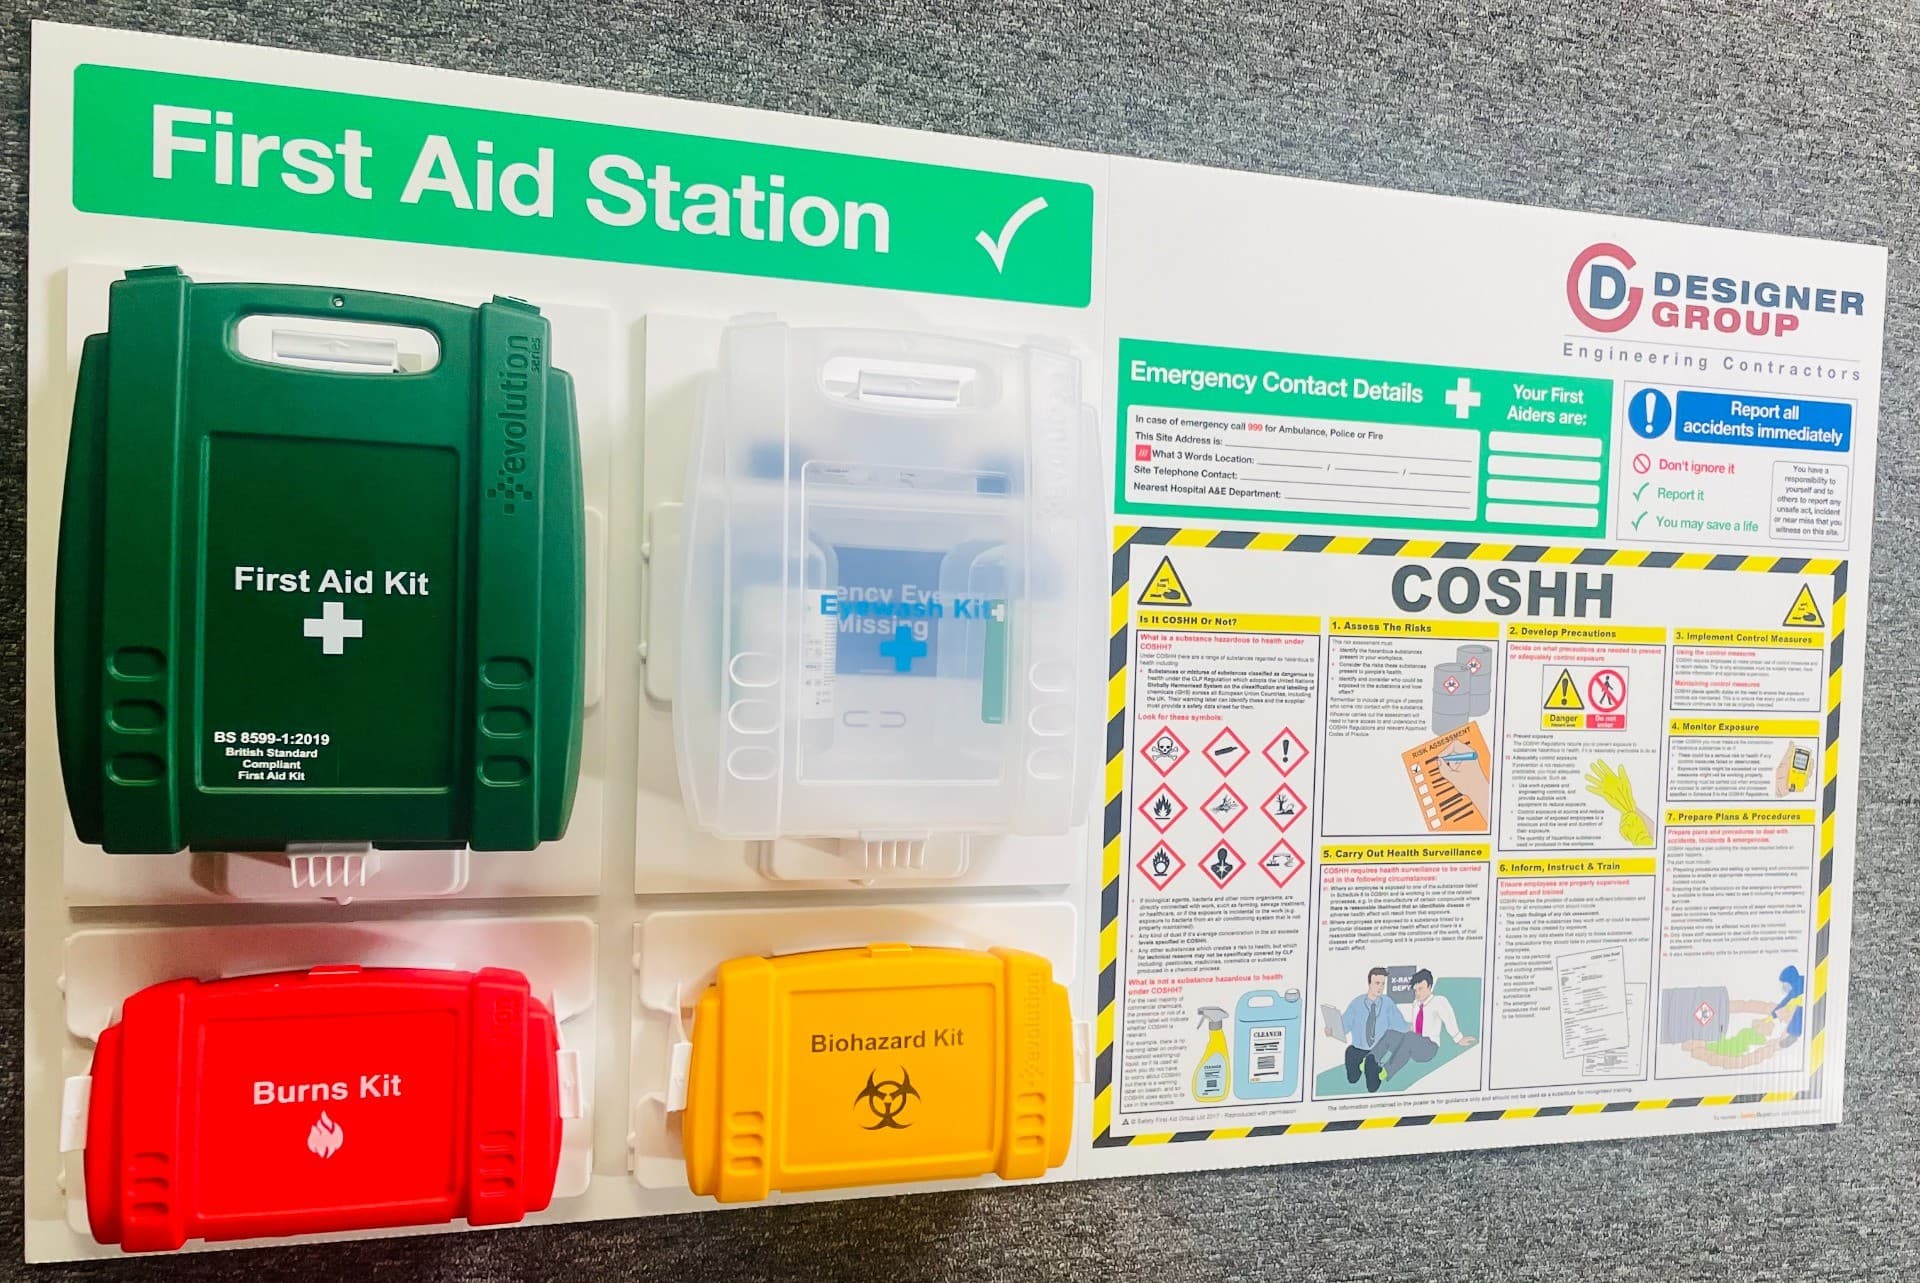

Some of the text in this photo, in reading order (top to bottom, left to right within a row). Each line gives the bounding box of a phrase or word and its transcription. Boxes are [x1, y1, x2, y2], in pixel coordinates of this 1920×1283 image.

[151, 104, 889, 251] First Aid Station
[1653, 271, 1864, 315] DESIGNER
[1651, 301, 1799, 337] GROUP
[1563, 342, 1861, 382] Engineering Contractors
[1130, 360, 1422, 403] Emergency Contact Details
[1513, 383, 1583, 404] Your First
[497, 335, 529, 475] evolution
[1730, 400, 1799, 420] Report all
[1506, 405, 1587, 425] Aiders are:
[1135, 414, 1144, 423] In
[1146, 416, 1167, 424] case
[1168, 417, 1179, 425] of
[1180, 419, 1228, 430] emergency
[1230, 422, 1246, 430] call
[1247, 422, 1263, 431] 999
[1264, 423, 1276, 432] for
[1278, 425, 1327, 437] Ambulance,
[1329, 428, 1355, 438] Police
[1367, 430, 1383, 440] Fire
[1683, 419, 1842, 446] accidents immediately
[1135, 430, 1222, 445] This Site Address is:
[1151, 449, 1254, 464] What 3 Words Location:
[1133, 464, 1237, 479] Site Telephone Contact:
[1658, 458, 1735, 474] Don't ignore it
[1133, 481, 1280, 498] Nearest Hospital A&E Department:
[1657, 486, 1704, 501] Report it
[1655, 515, 1758, 532] You may save a life
[234, 566, 428, 595] First Aid Kit
[1392, 564, 1613, 618] COSHH
[820, 593, 992, 621] Eyewash Kit
[1139, 615, 1148, 623] Is
[1151, 615, 1158, 623] It
[1162, 615, 1197, 624] COSHH
[1214, 617, 1237, 625] Not?
[1332, 620, 1431, 632] 1. Assess The Risks
[1509, 626, 1616, 638] 2. Develop Precautions
[1675, 631, 1812, 643] 3. Implement Control Measures
[1550, 714, 1577, 723] Danger
[1671, 721, 1759, 732] 4. Monitor Exposure
[213, 731, 329, 745] BS 8599-1:2019
[1411, 726, 1471, 759] RISK ASSESSMENT
[225, 746, 318, 758] British Standard
[242, 760, 301, 770] Compliant
[237, 770, 305, 780] First Aid Kit
[1667, 812, 1800, 822] 7. Prepare Plans & Procedures
[1322, 848, 1482, 859] 5. Carry Out Health Surveillance
[1511, 863, 1544, 872] Inform,
[1547, 863, 1584, 871] Instruct
[1586, 862, 1594, 870] &
[1597, 862, 1620, 870] Train
[811, 1028, 962, 1052] Biohazard Kit
[253, 1074, 400, 1104] Burns Kit
